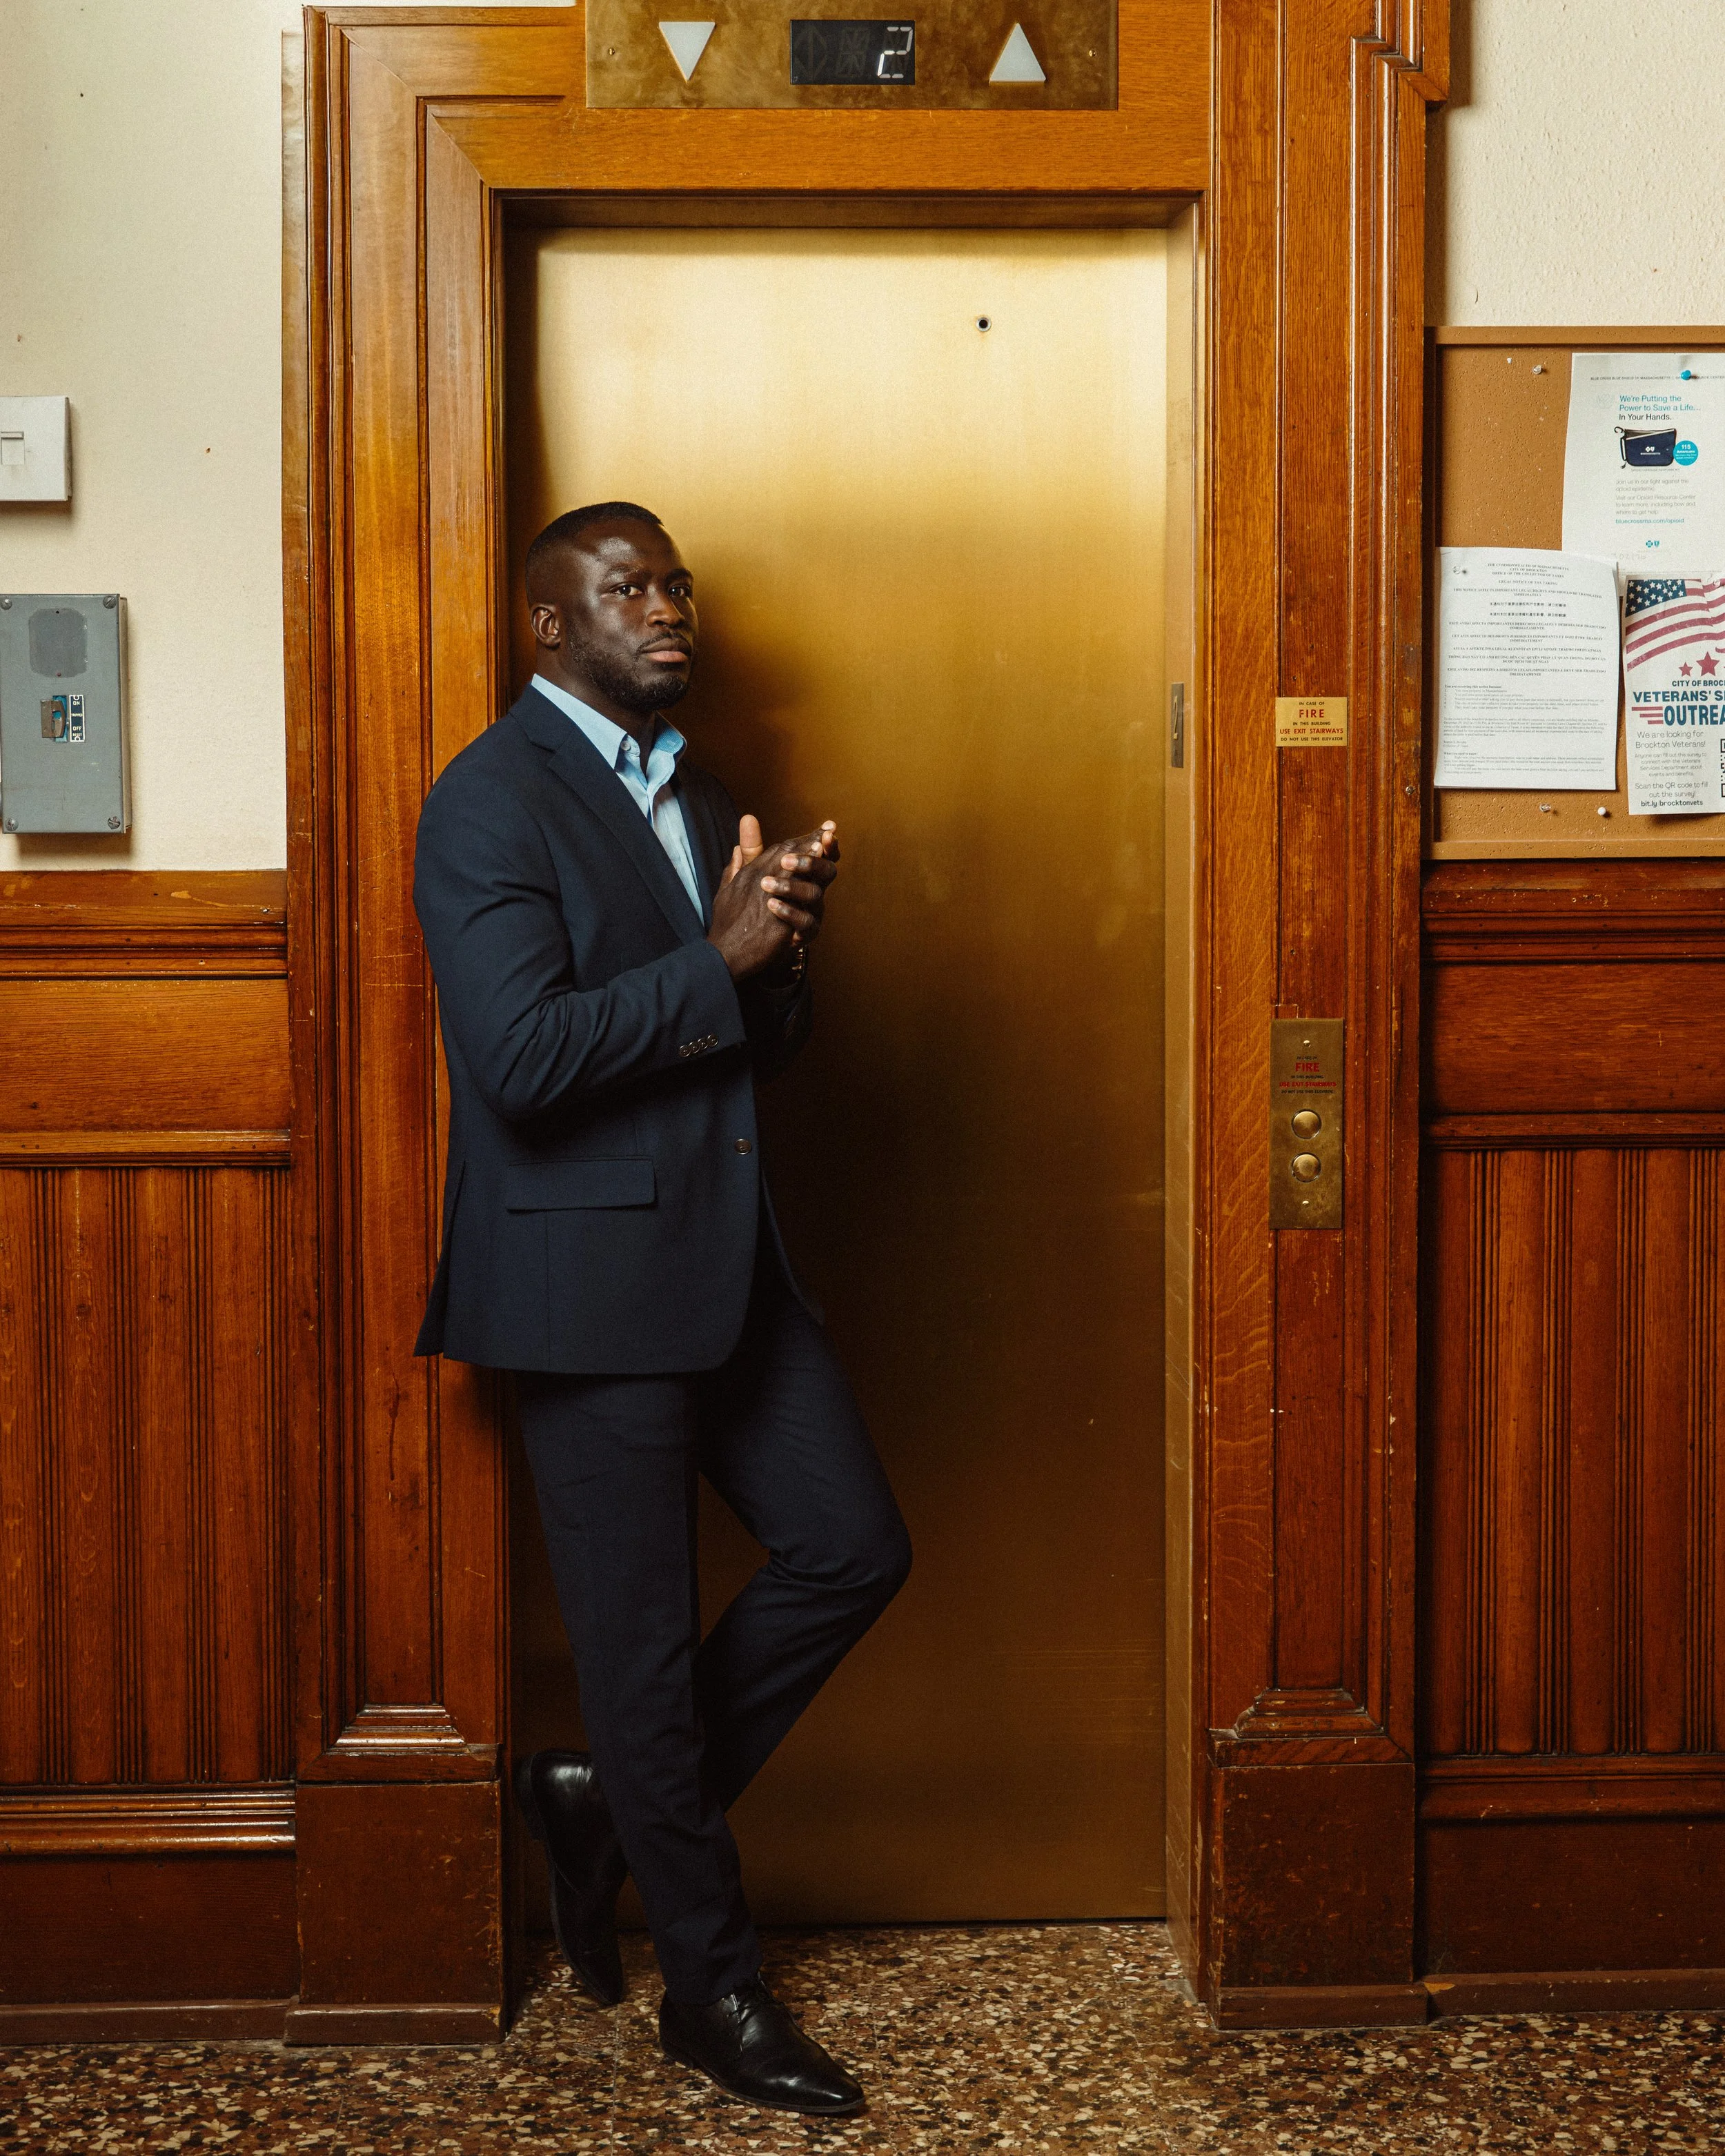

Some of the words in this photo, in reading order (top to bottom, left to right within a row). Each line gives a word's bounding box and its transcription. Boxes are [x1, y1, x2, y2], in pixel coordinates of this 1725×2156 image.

[877, 26, 913, 79] 2
[1642, 395, 1668, 403] Putting
[1633, 691, 1711, 702] VETERANS'
[1299, 709, 1324, 718] FIRE
[1666, 731, 1691, 739] looking
[1295, 1062, 1319, 1072] FIRE
